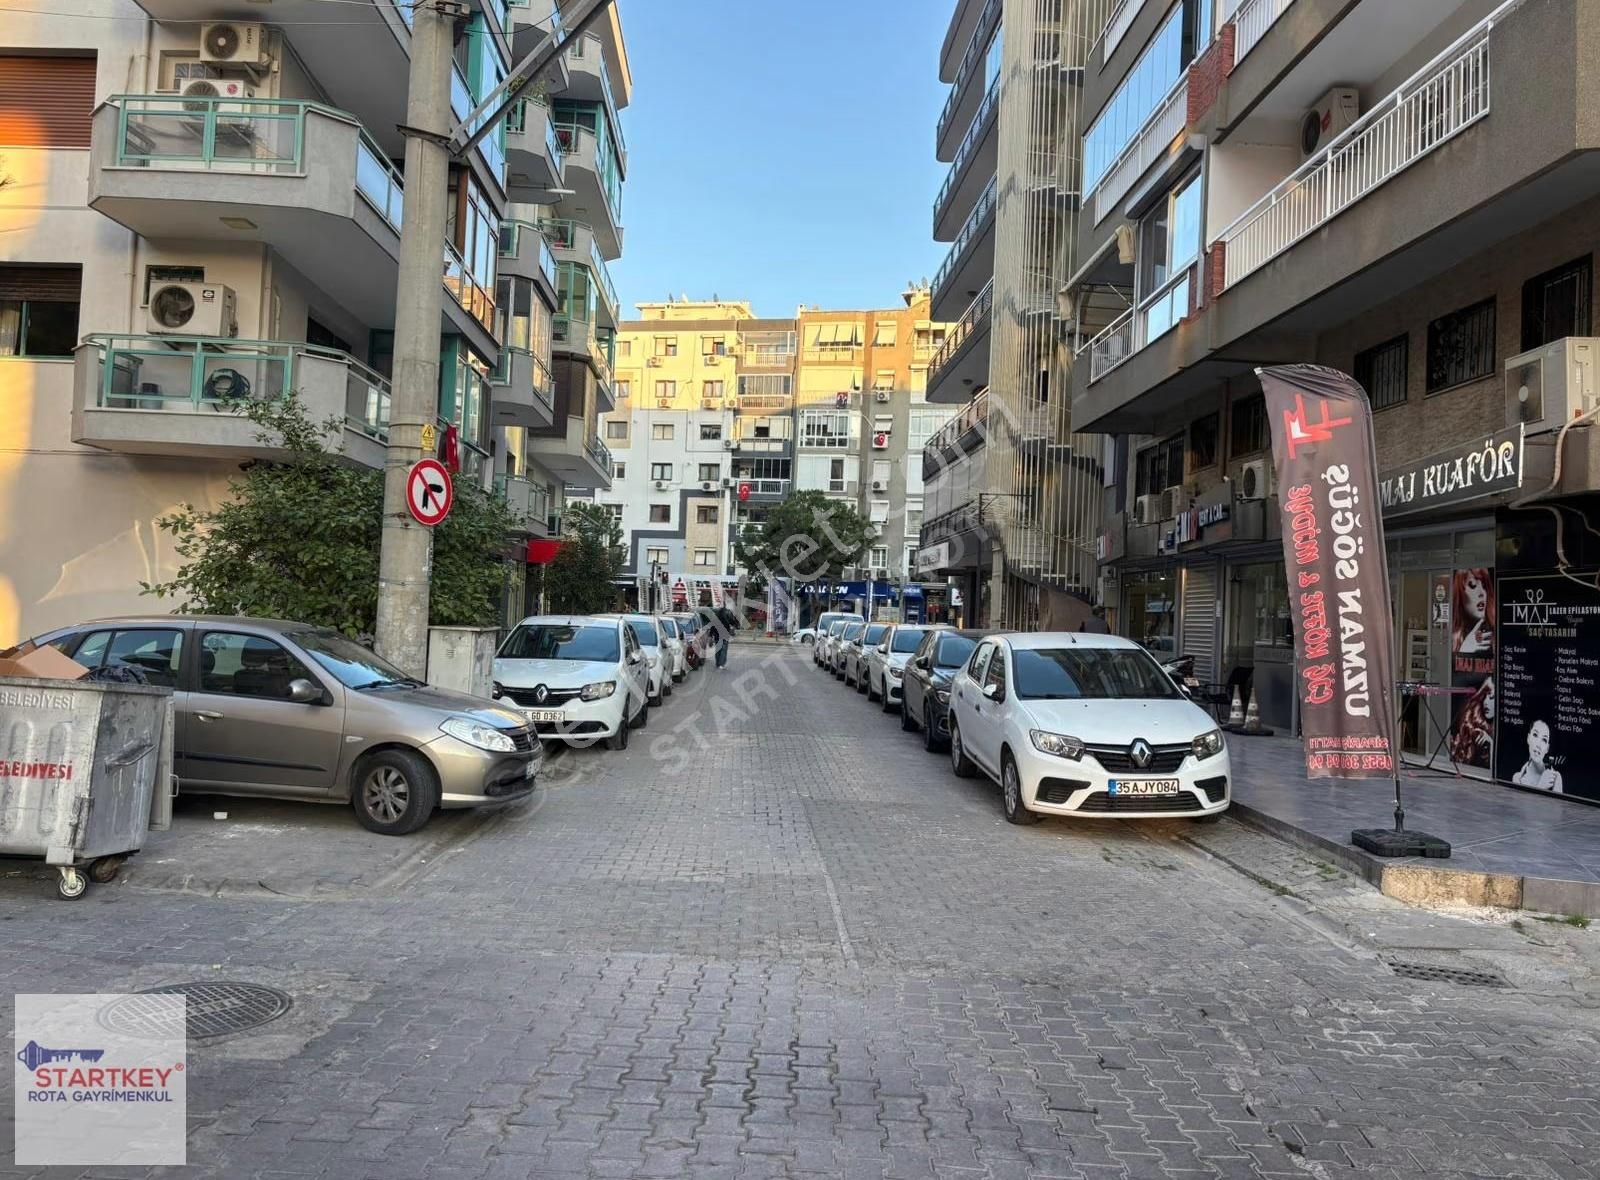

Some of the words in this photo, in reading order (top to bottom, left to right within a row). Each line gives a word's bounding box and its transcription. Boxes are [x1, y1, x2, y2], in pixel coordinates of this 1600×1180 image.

[1381, 472, 1416, 507] MAJ
[1422, 439, 1515, 497] KUAFÖR
[1513, 600, 1549, 627] İMAJ
[1549, 606, 1567, 614] LAZER
[0, 758, 73, 780] ELEDİYESİ
